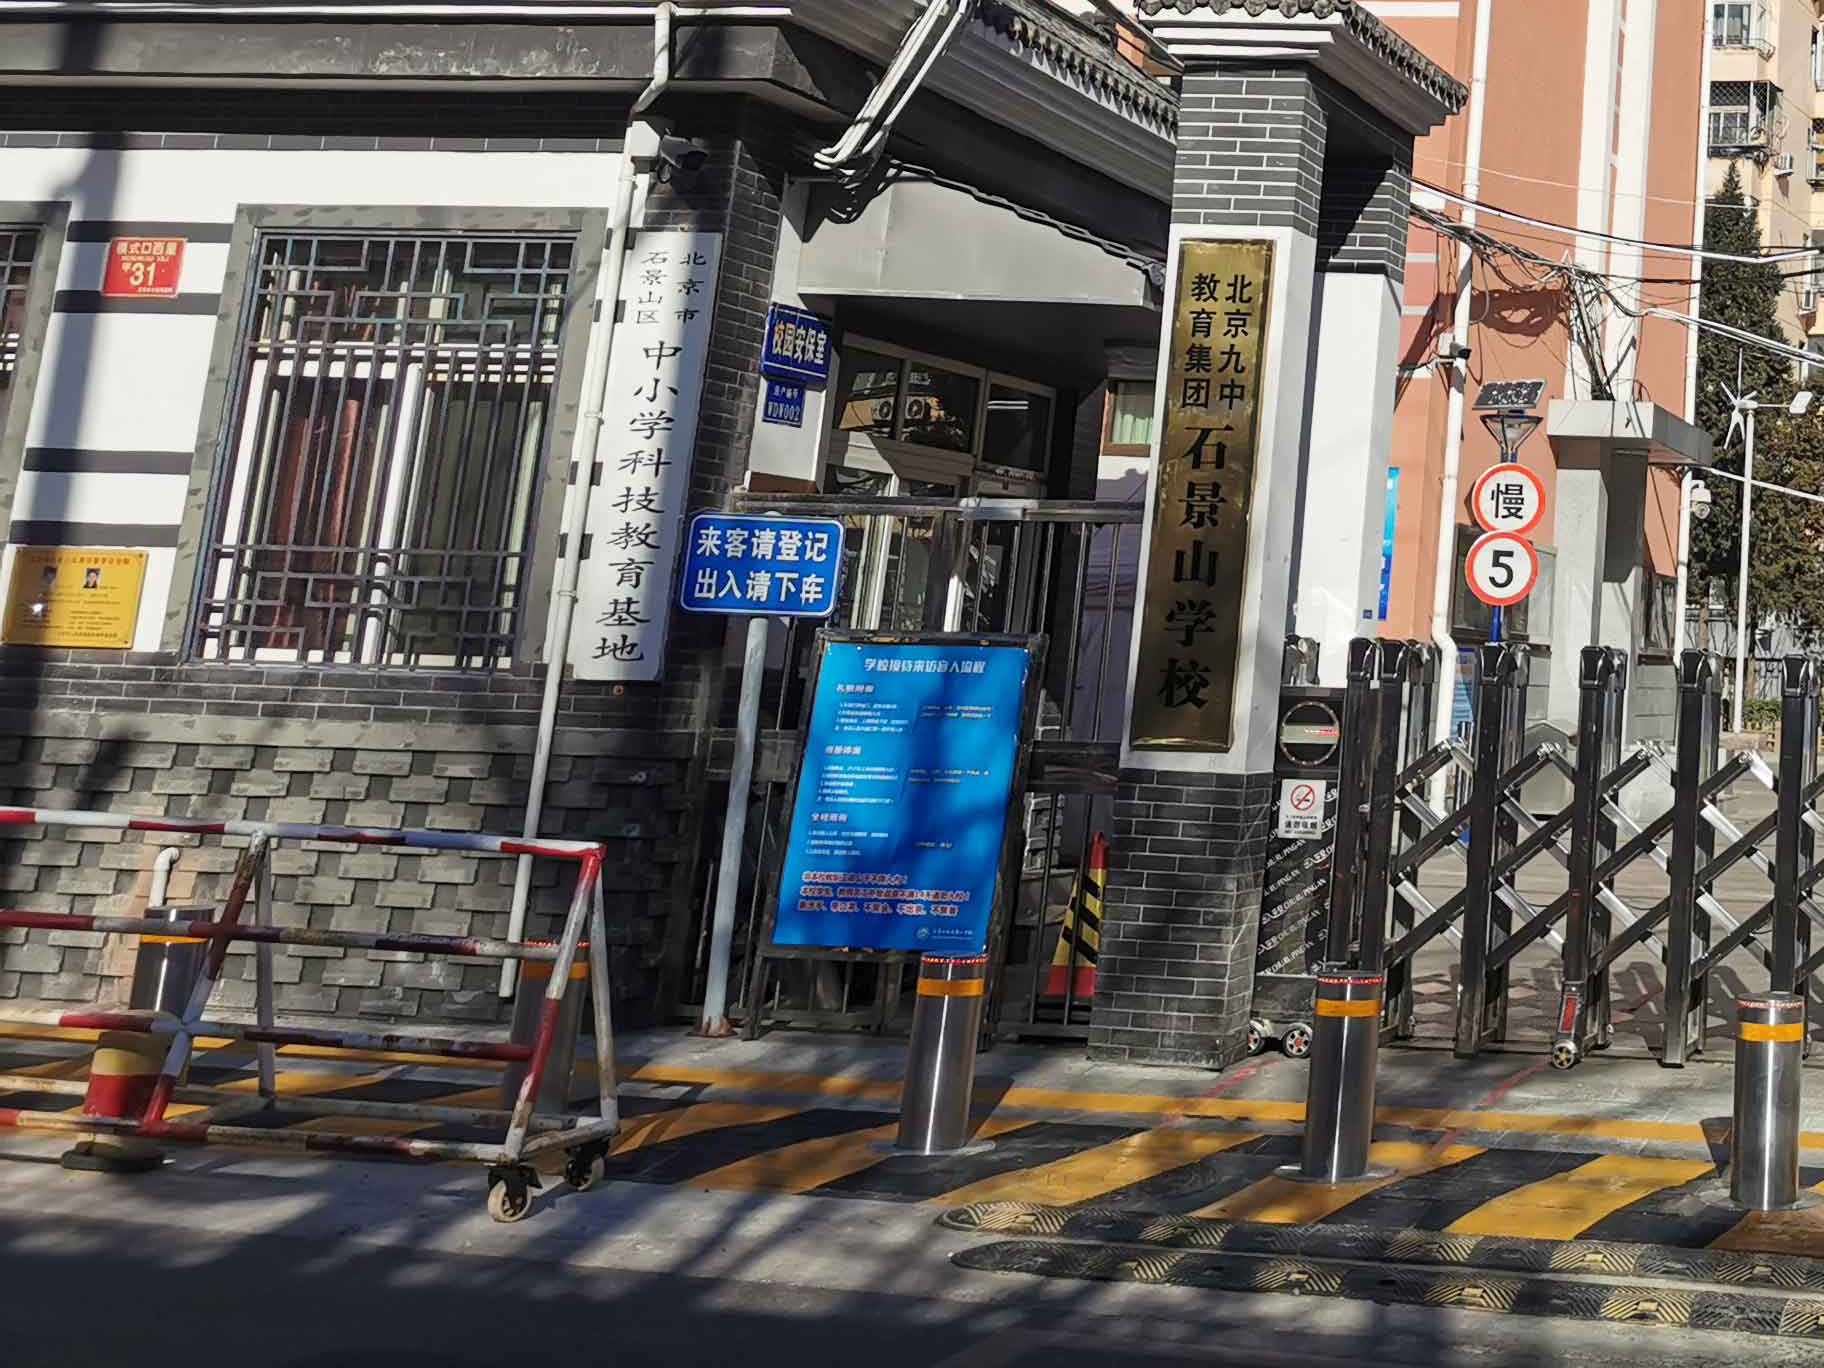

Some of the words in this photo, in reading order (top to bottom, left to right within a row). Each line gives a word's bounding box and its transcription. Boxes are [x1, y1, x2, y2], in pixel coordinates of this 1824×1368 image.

[636, 250, 669, 325] 石景山区
[674, 250, 707, 324] 北京市
[772, 319, 827, 365] 校园安保室
[1180, 272, 1221, 411] 教育集团
[1216, 273, 1253, 411] 北京九中
[591, 339, 682, 663] 中小学科技教育基地
[1490, 482, 1525, 520] 慢
[696, 525, 828, 563] 来客请登记
[1157, 423, 1234, 712] 石景山学校
[1488, 549, 1515, 589] 5
[694, 569, 825, 604] 出入请下车
